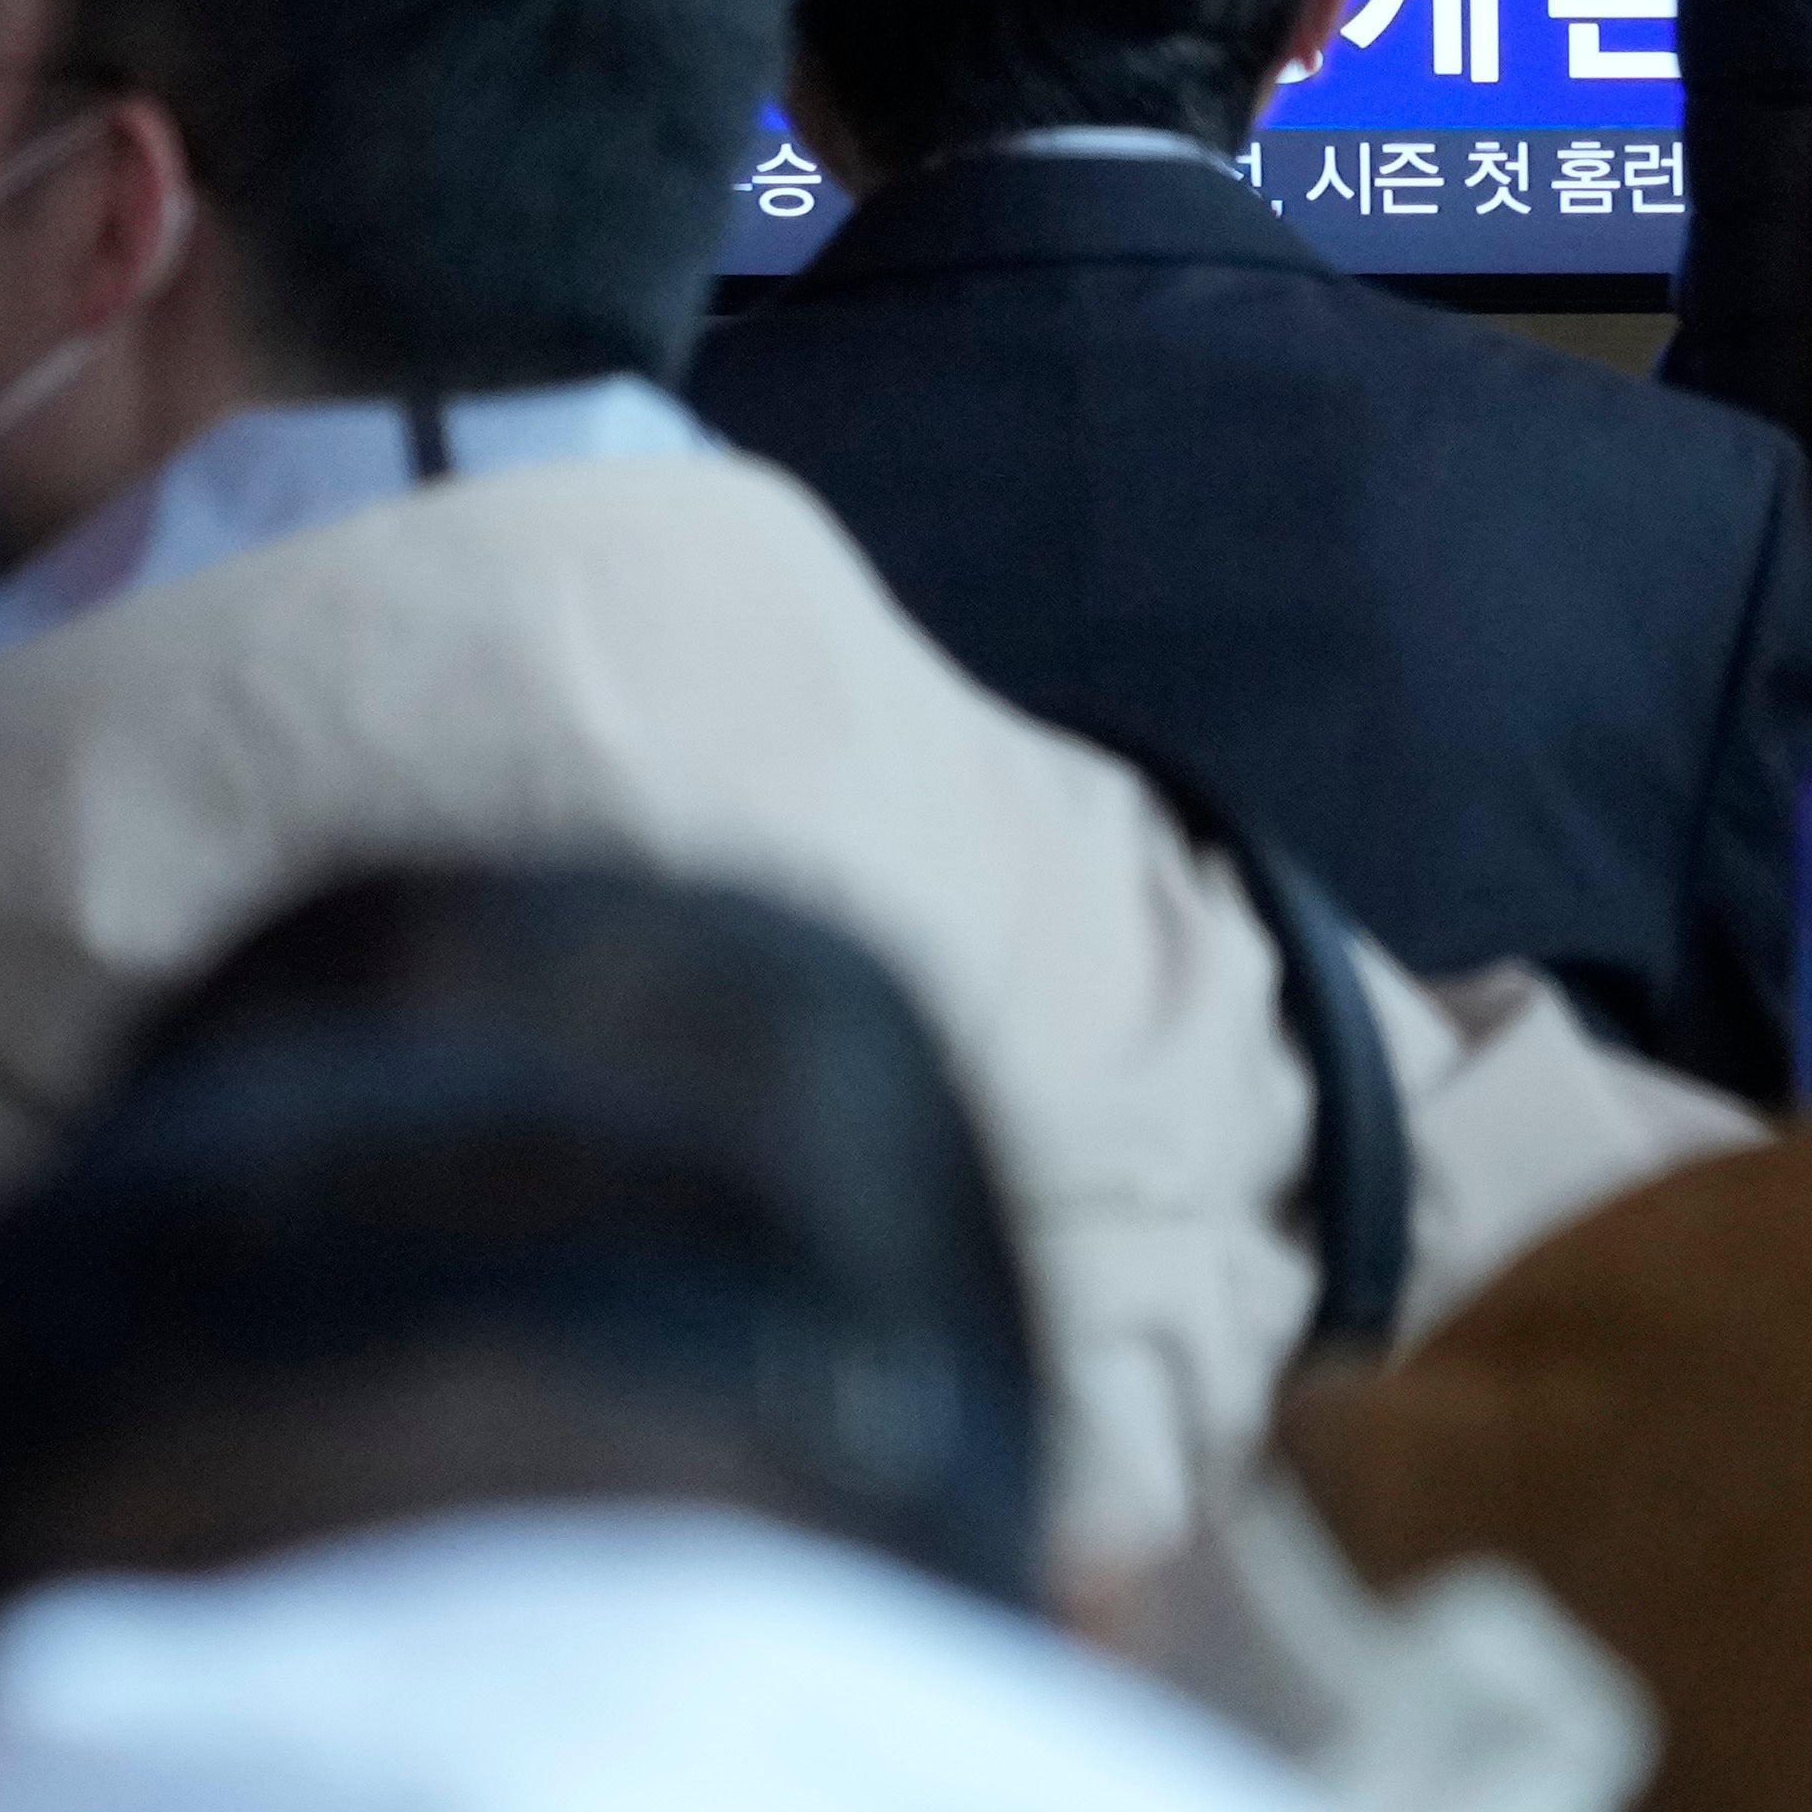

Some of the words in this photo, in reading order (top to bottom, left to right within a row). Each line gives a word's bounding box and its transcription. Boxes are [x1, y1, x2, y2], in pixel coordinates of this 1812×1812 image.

[734, 143, 823, 217] 승
[1305, 141, 1445, 215] 시즌
[1464, 141, 1532, 215] 첫
[1550, 141, 1686, 215] 홈런
